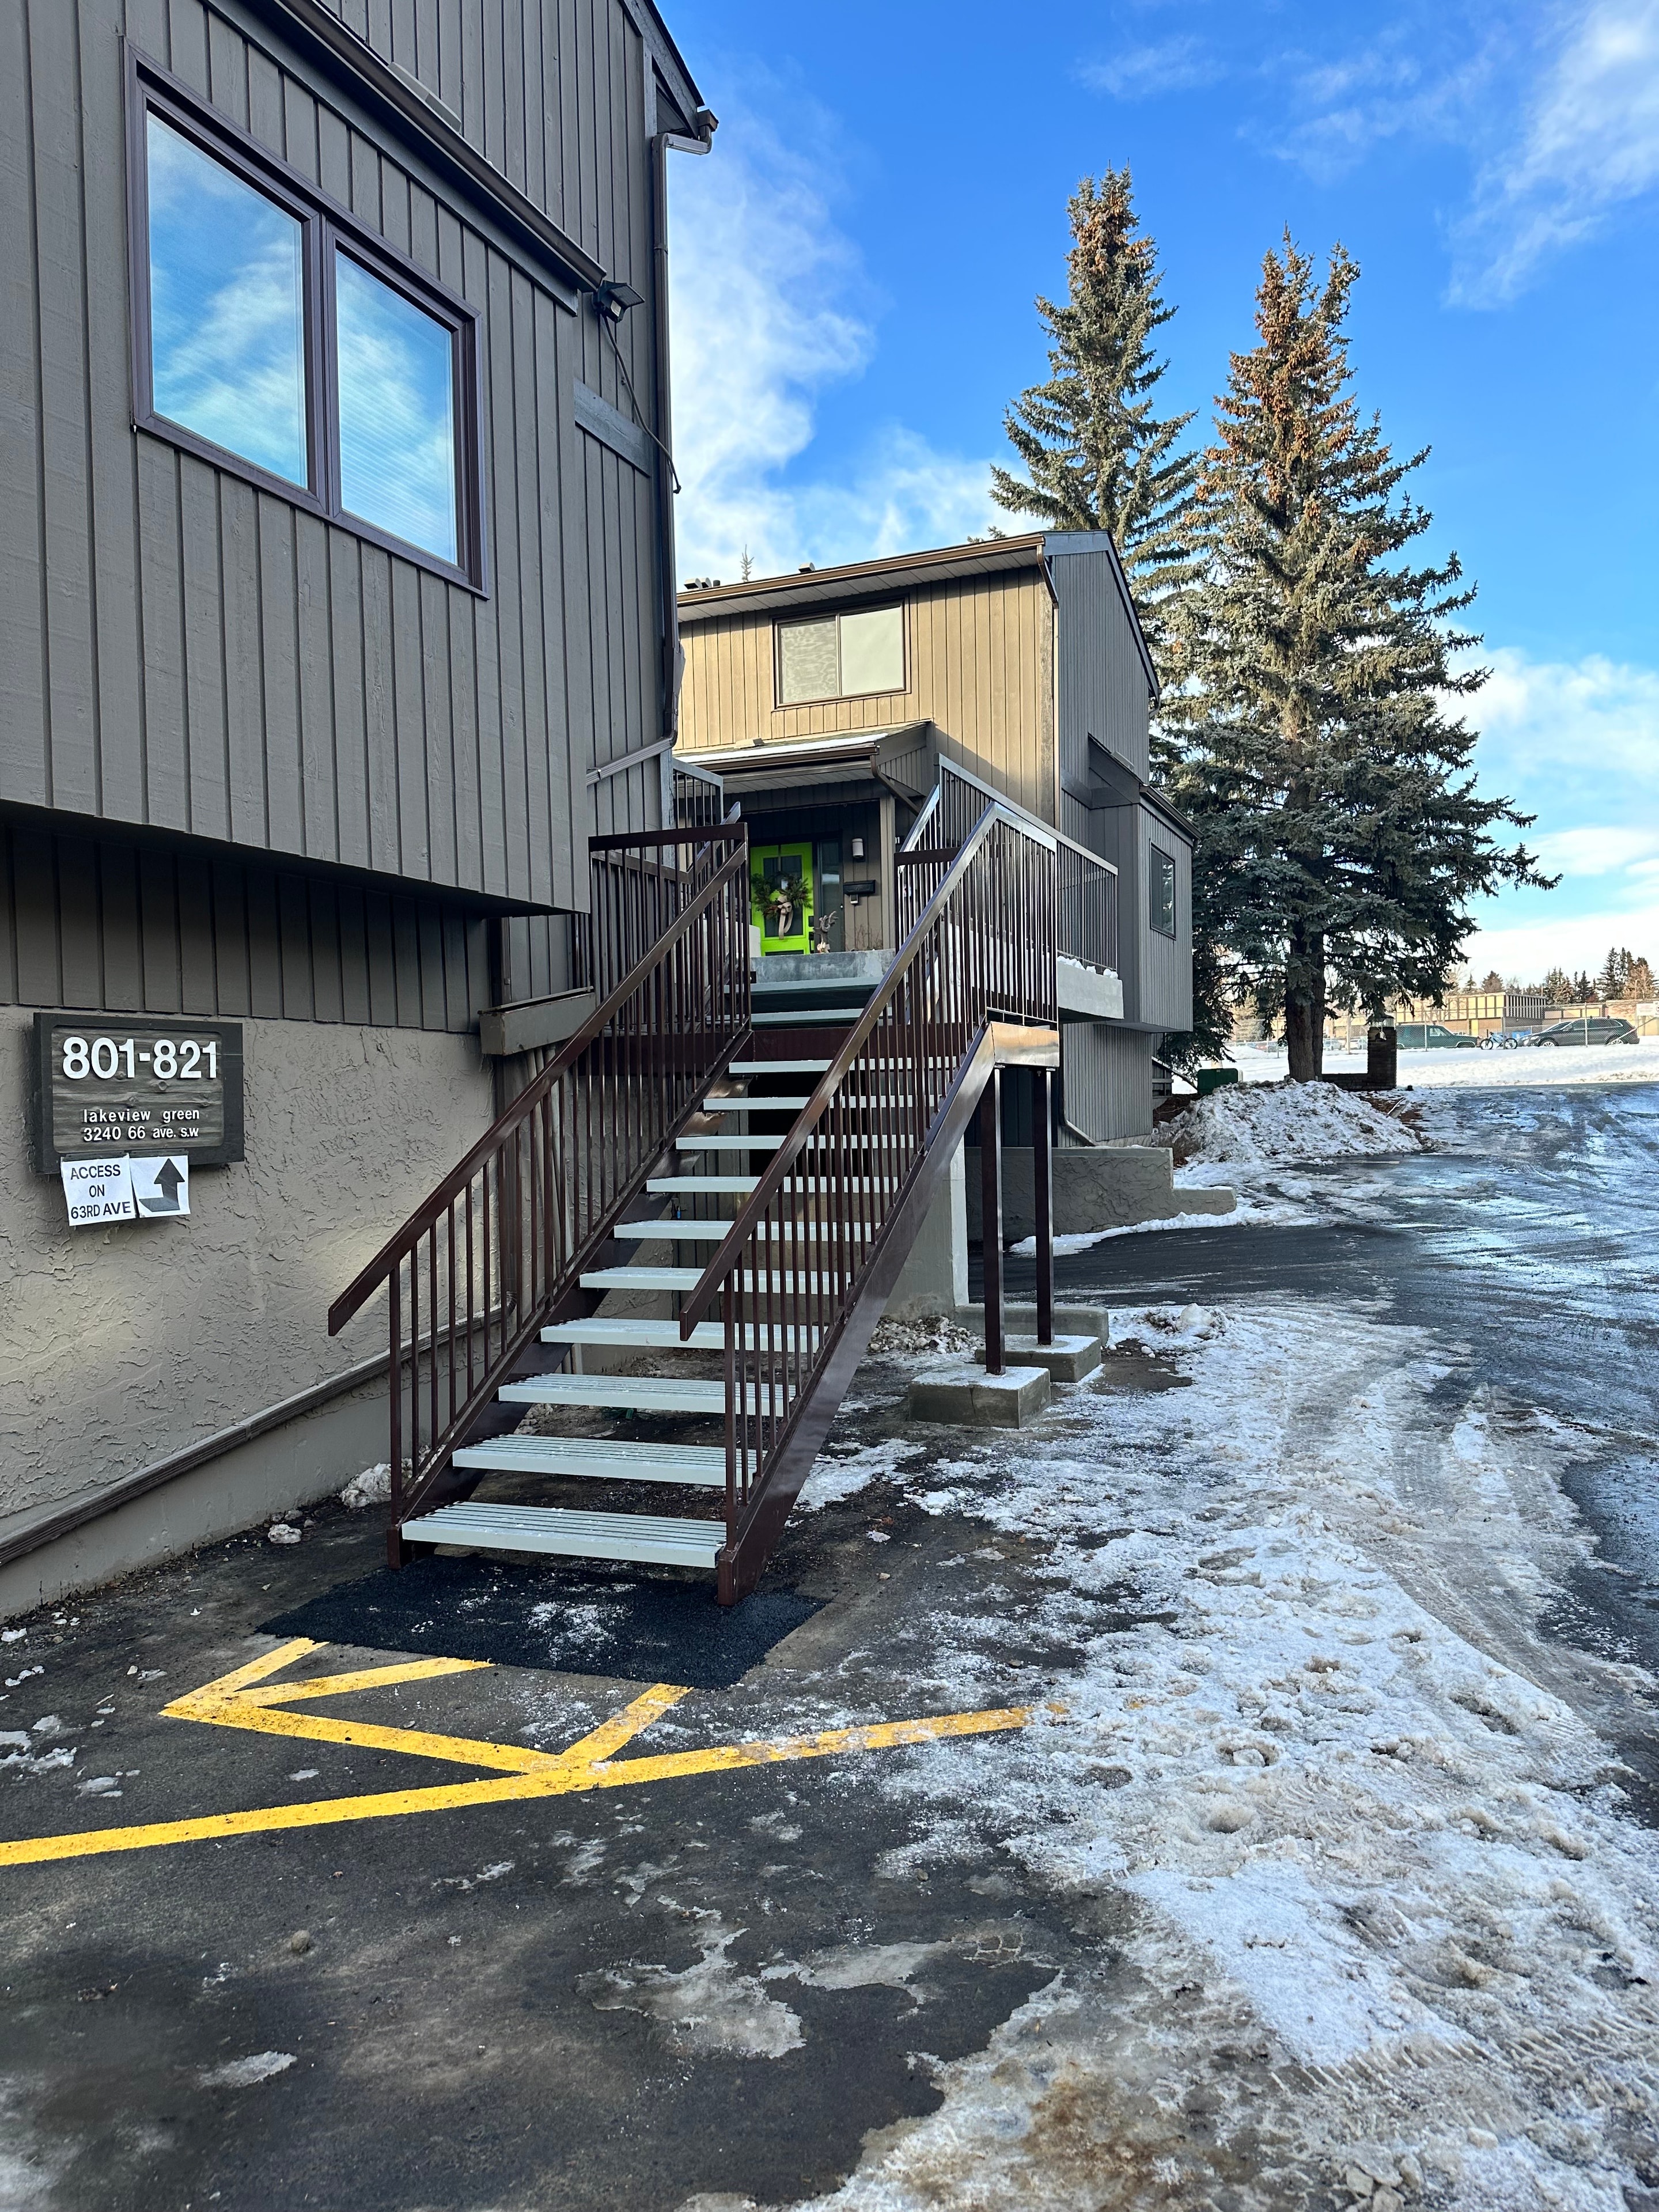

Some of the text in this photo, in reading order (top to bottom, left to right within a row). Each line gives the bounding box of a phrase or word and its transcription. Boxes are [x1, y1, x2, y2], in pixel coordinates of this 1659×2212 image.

[63, 1036, 217, 1079] 801-821
[84, 1109, 200, 1123] lakeview green
[84, 1126, 122, 1142] 3240
[128, 1126, 146, 1140] 66
[153, 1128, 176, 1138] ave.
[70, 1164, 121, 1180] ACCESS
[89, 1184, 105, 1198] ON
[70, 1201, 132, 1219] 63RD AVE
